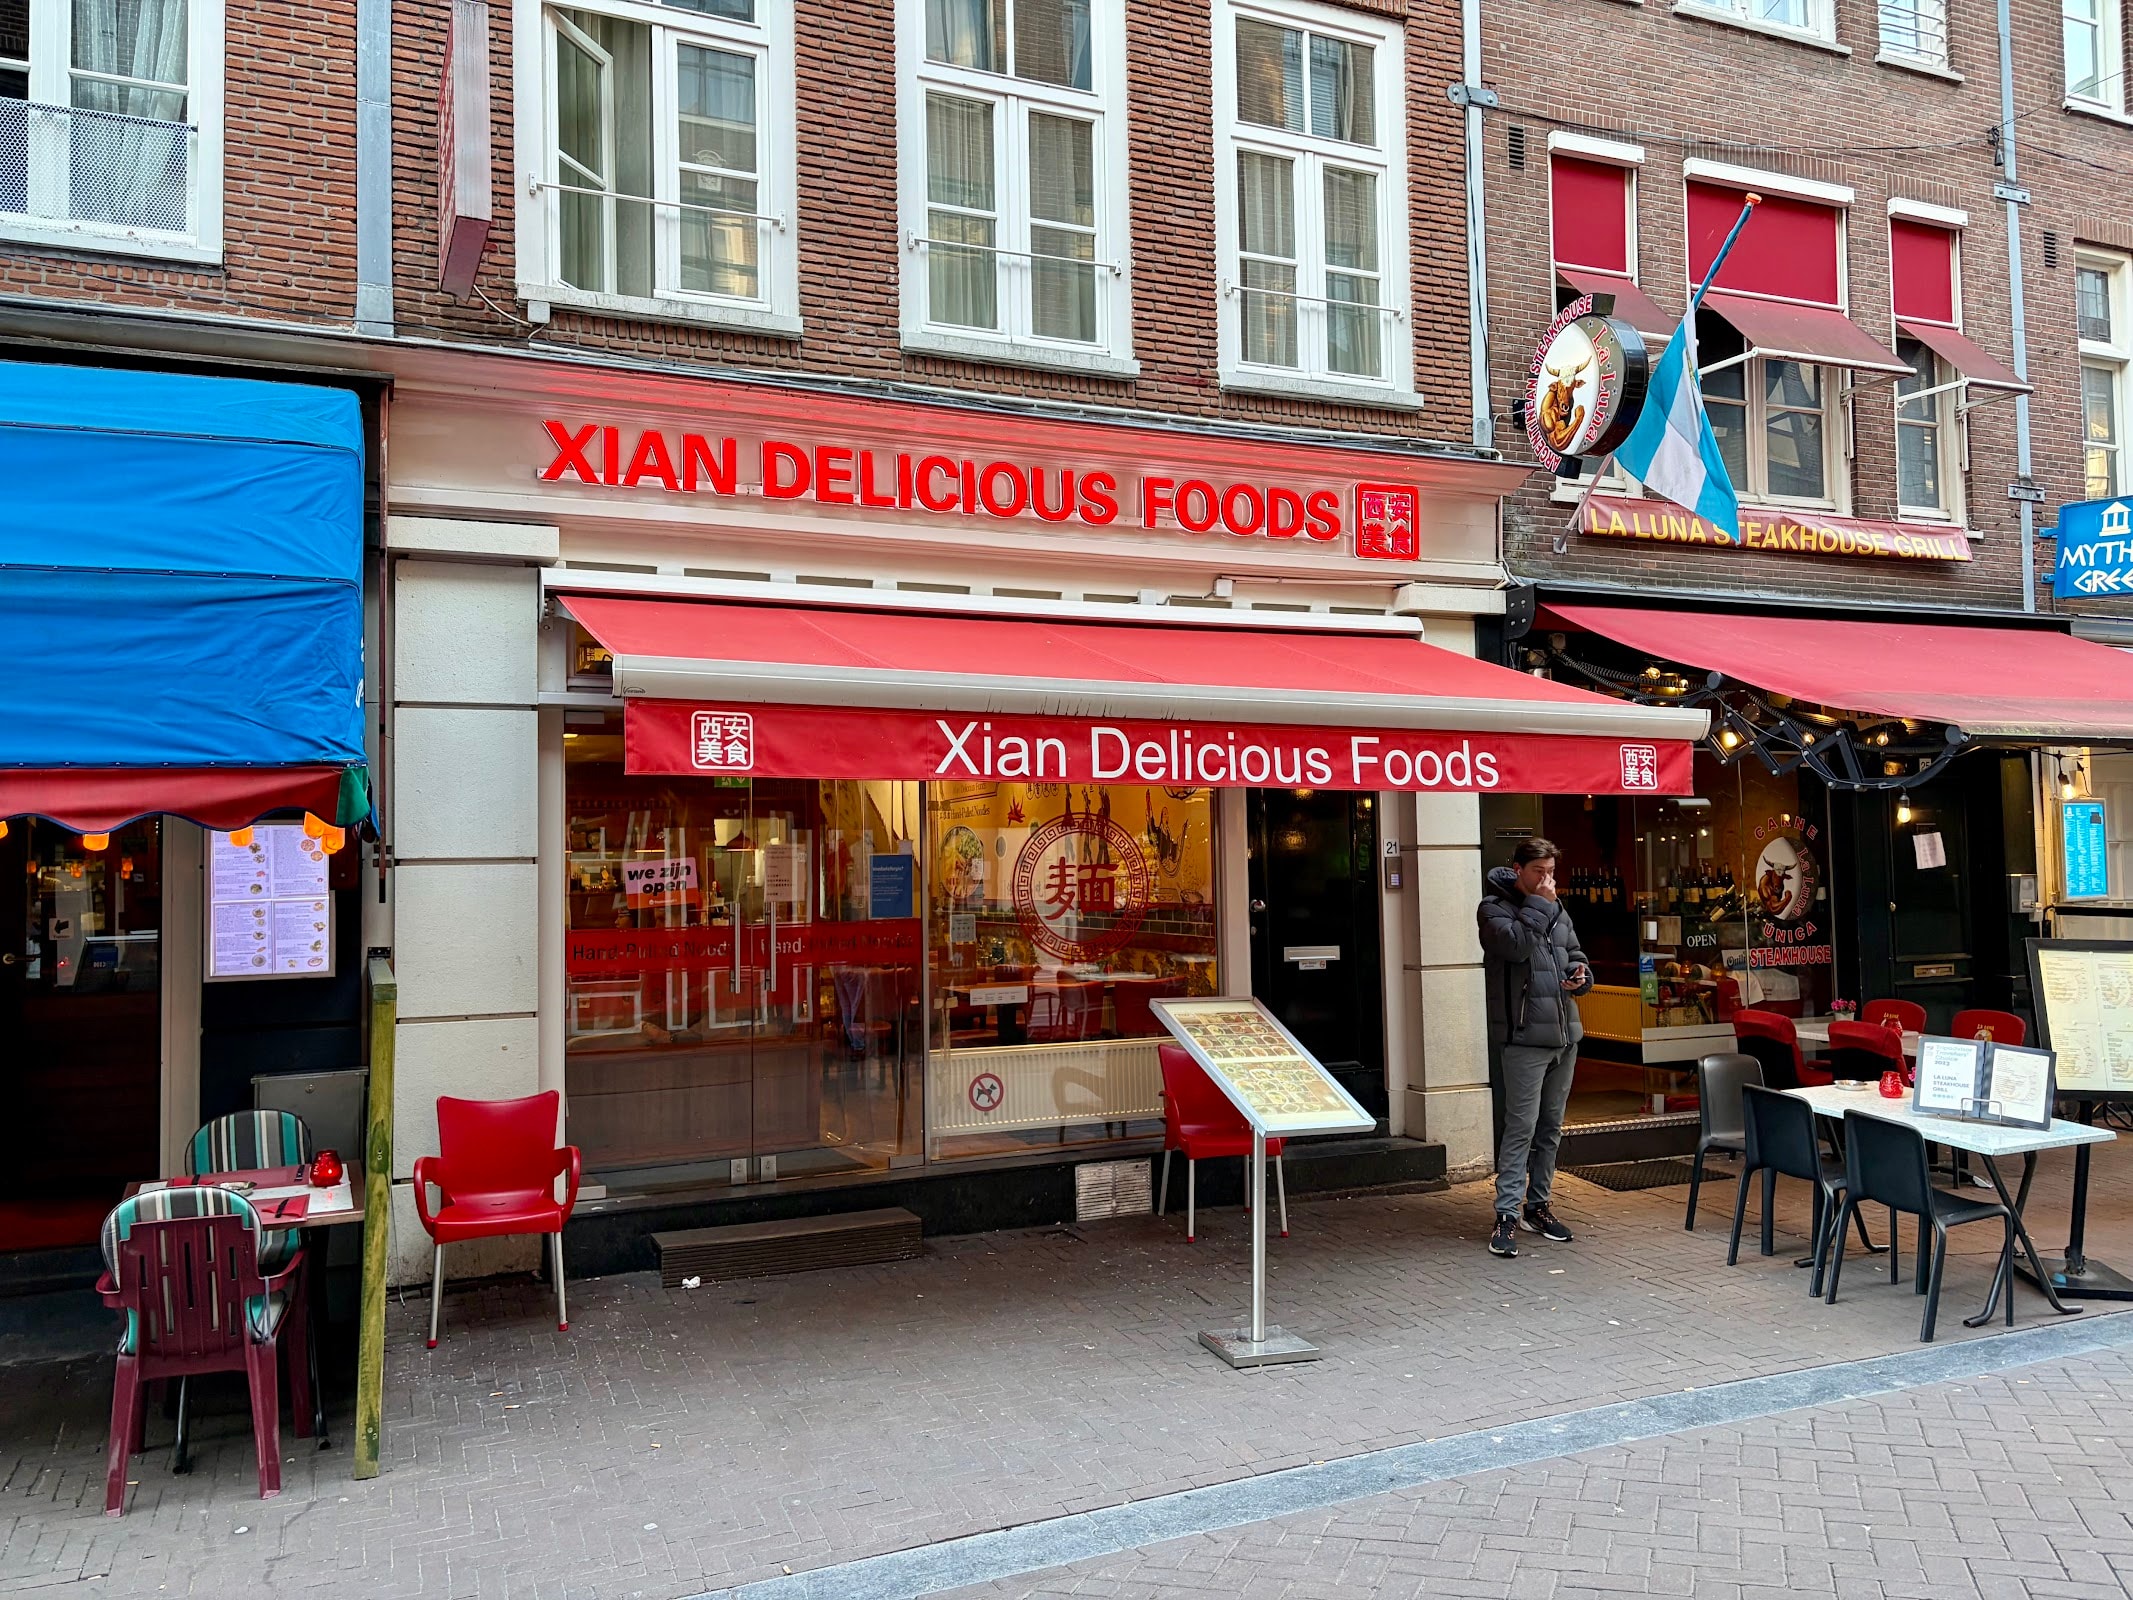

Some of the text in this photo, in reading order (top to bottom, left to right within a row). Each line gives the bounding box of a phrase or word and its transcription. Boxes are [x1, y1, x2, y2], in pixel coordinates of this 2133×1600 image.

[1530, 294, 1593, 375] STEAKHOUSE
[1585, 325, 1616, 442] La Luna
[541, 420, 1341, 542] XIAN DELICIOUS FOODS
[1362, 491, 1410, 523] 西安
[1591, 508, 1968, 561] LA LUNA SEAKHOUSE GRILL
[697, 716, 749, 740] 西安
[697, 739, 749, 765] 美食
[935, 720, 1500, 787] Xian Delicious Foods
[1623, 749, 1654, 766] 西安
[1625, 766, 1654, 785] 美食
[1386, 841, 1397, 854] 21
[628, 863, 691, 880] we zijn
[643, 881, 686, 896] open
[1687, 934, 1717, 947] OPEN
[1750, 944, 1832, 967] STEAKHOUSE
